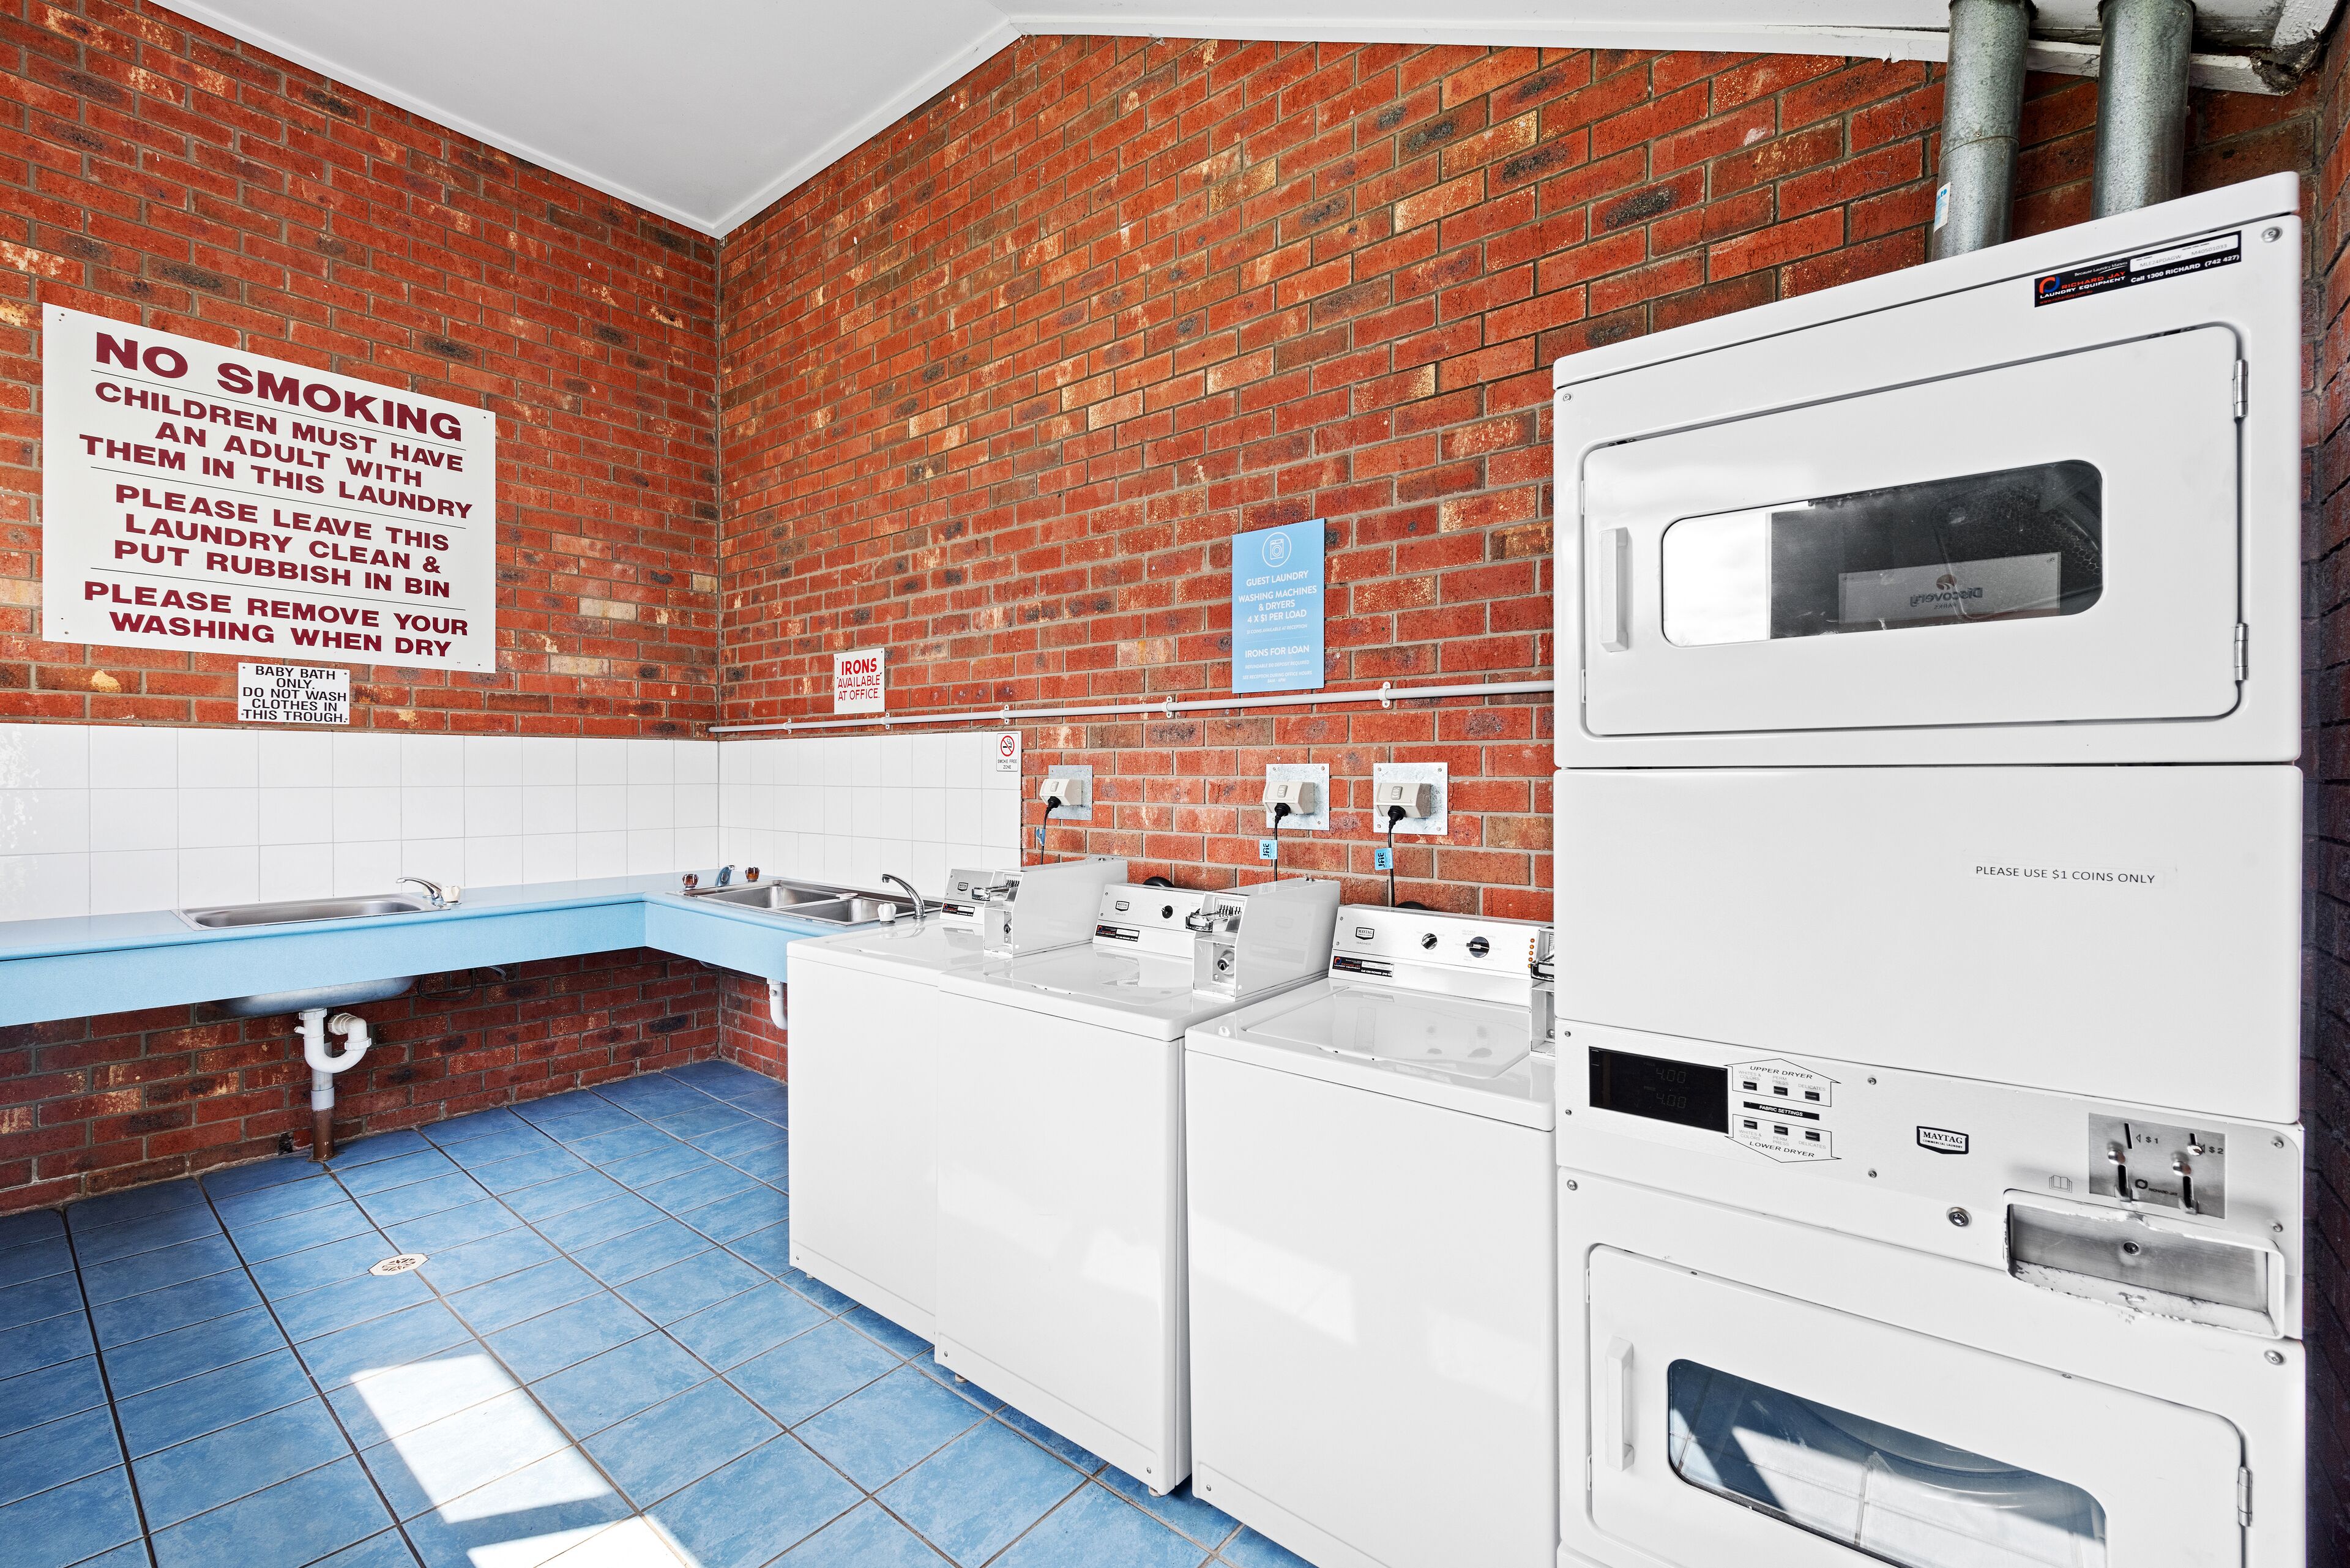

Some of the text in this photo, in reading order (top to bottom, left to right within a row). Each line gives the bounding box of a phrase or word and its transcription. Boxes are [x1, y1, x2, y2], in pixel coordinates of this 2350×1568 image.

[2165, 263, 2200, 275] RICHARD
[2040, 276, 2125, 299] LAUNDRY EQUIPMENT
[2062, 276, 2104, 289] RICHARD
[96, 332, 462, 442] NO SMOKING
[95, 381, 463, 472] CHILDREN MUST HAVE
[155, 422, 422, 487] AN ADULT WITH
[80, 434, 472, 519] THEM IN THIS LAUNDRY
[116, 484, 449, 551] PLEASE LEAVE THIS
[126, 513, 440, 573] LAUNDRY CLEAN &
[115, 540, 449, 599] PUT RUBBISH IN BIN
[1247, 570, 1308, 586] GUEST LAUNDRY
[1239, 585, 1316, 603] WASHING MACHINES
[84, 581, 468, 636] PLEASE REMOVE YOUR
[1266, 599, 1295, 610] DRYERS
[1269, 613, 1283, 621] PER
[1286, 610, 1307, 619] LOAD
[109, 611, 451, 658] WASHING WHEN DRY
[1245, 645, 1309, 658] IRONS FOR LOAN
[256, 666, 335, 679] BABY BATH
[841, 658, 877, 675] IRONS
[277, 678, 315, 689] ONLY.
[838, 674, 880, 688] AVAILABLE
[243, 687, 346, 701] DO NOT WASH
[838, 688, 880, 701] AT OFFICE.
[252, 698, 337, 711] CLOTHES IN
[243, 709, 346, 722] THIS TROUGH.
[1976, 866, 2155, 883] PLEASE USE $1 COINS ONLY
[1782, 1070, 1812, 1079] DRYER
[1923, 1131, 1963, 1143] MAYTAG
[1750, 1141, 1815, 1157] LOWER DRYER
